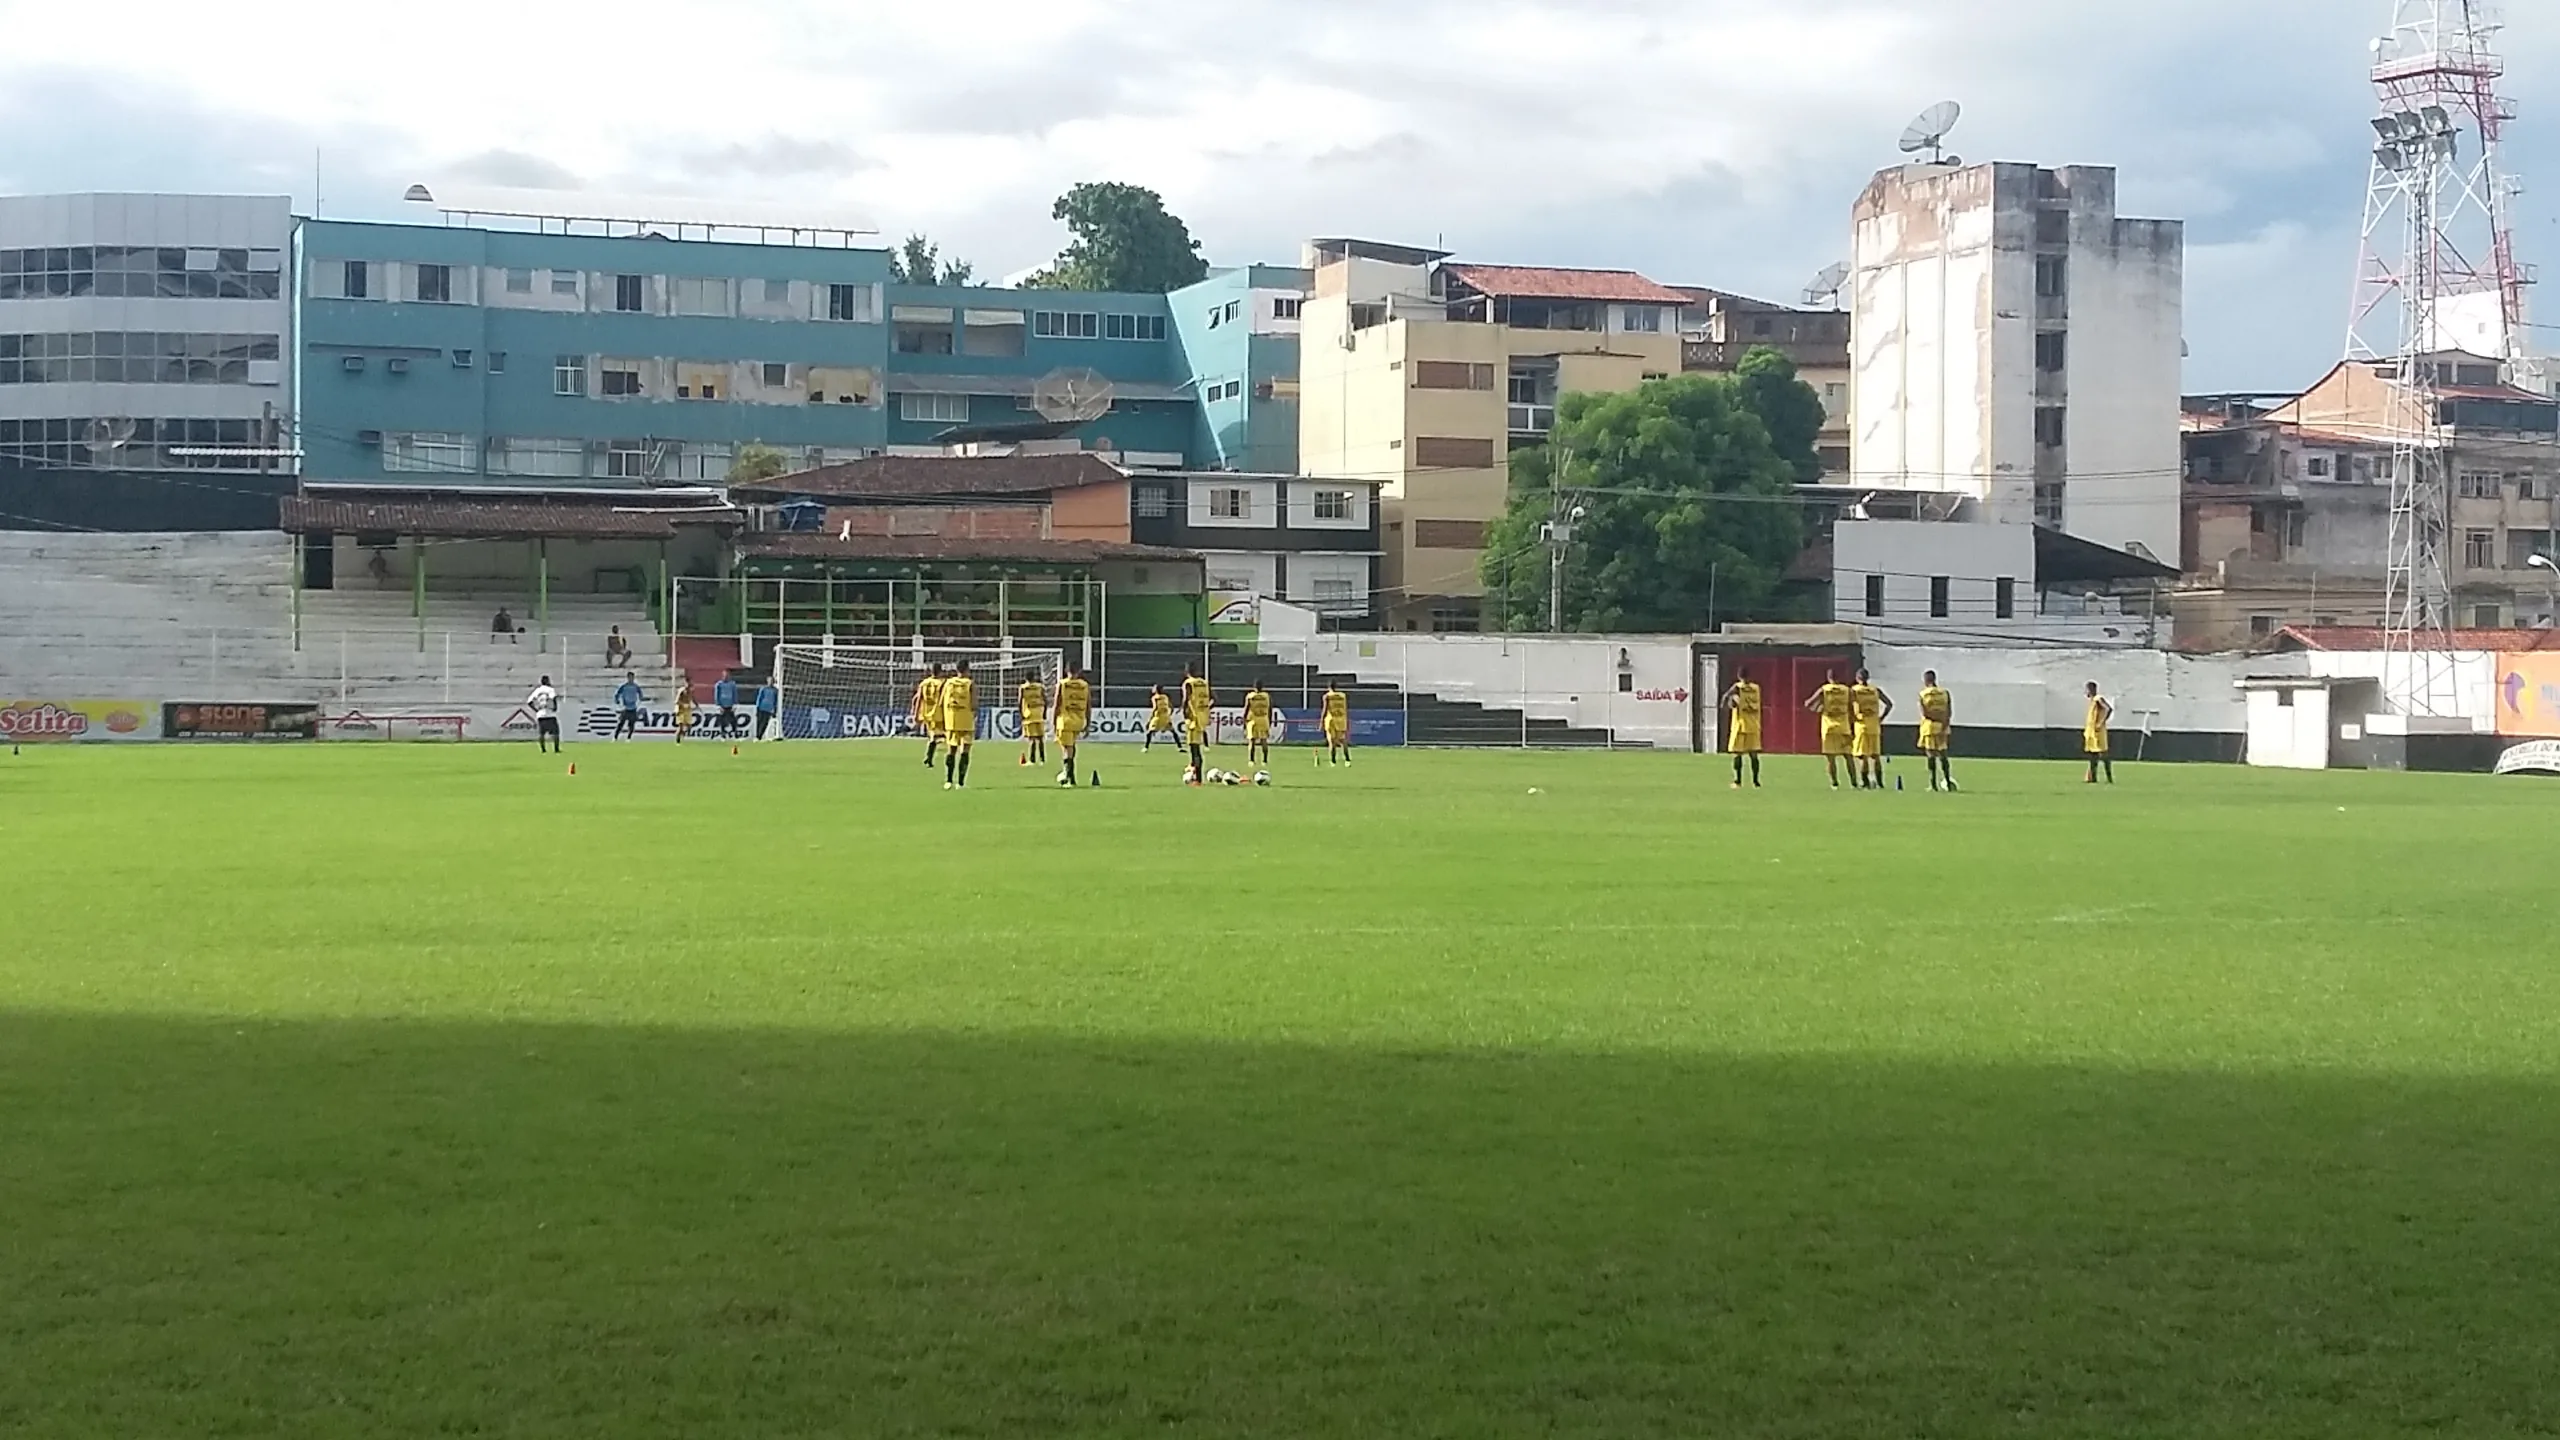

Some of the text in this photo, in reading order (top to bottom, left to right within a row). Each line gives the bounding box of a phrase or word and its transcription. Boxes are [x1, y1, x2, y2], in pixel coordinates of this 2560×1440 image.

[1636, 688, 1672, 701] SAÍDA
[0, 703, 87, 735] Selita
[633, 707, 752, 728] Antono
